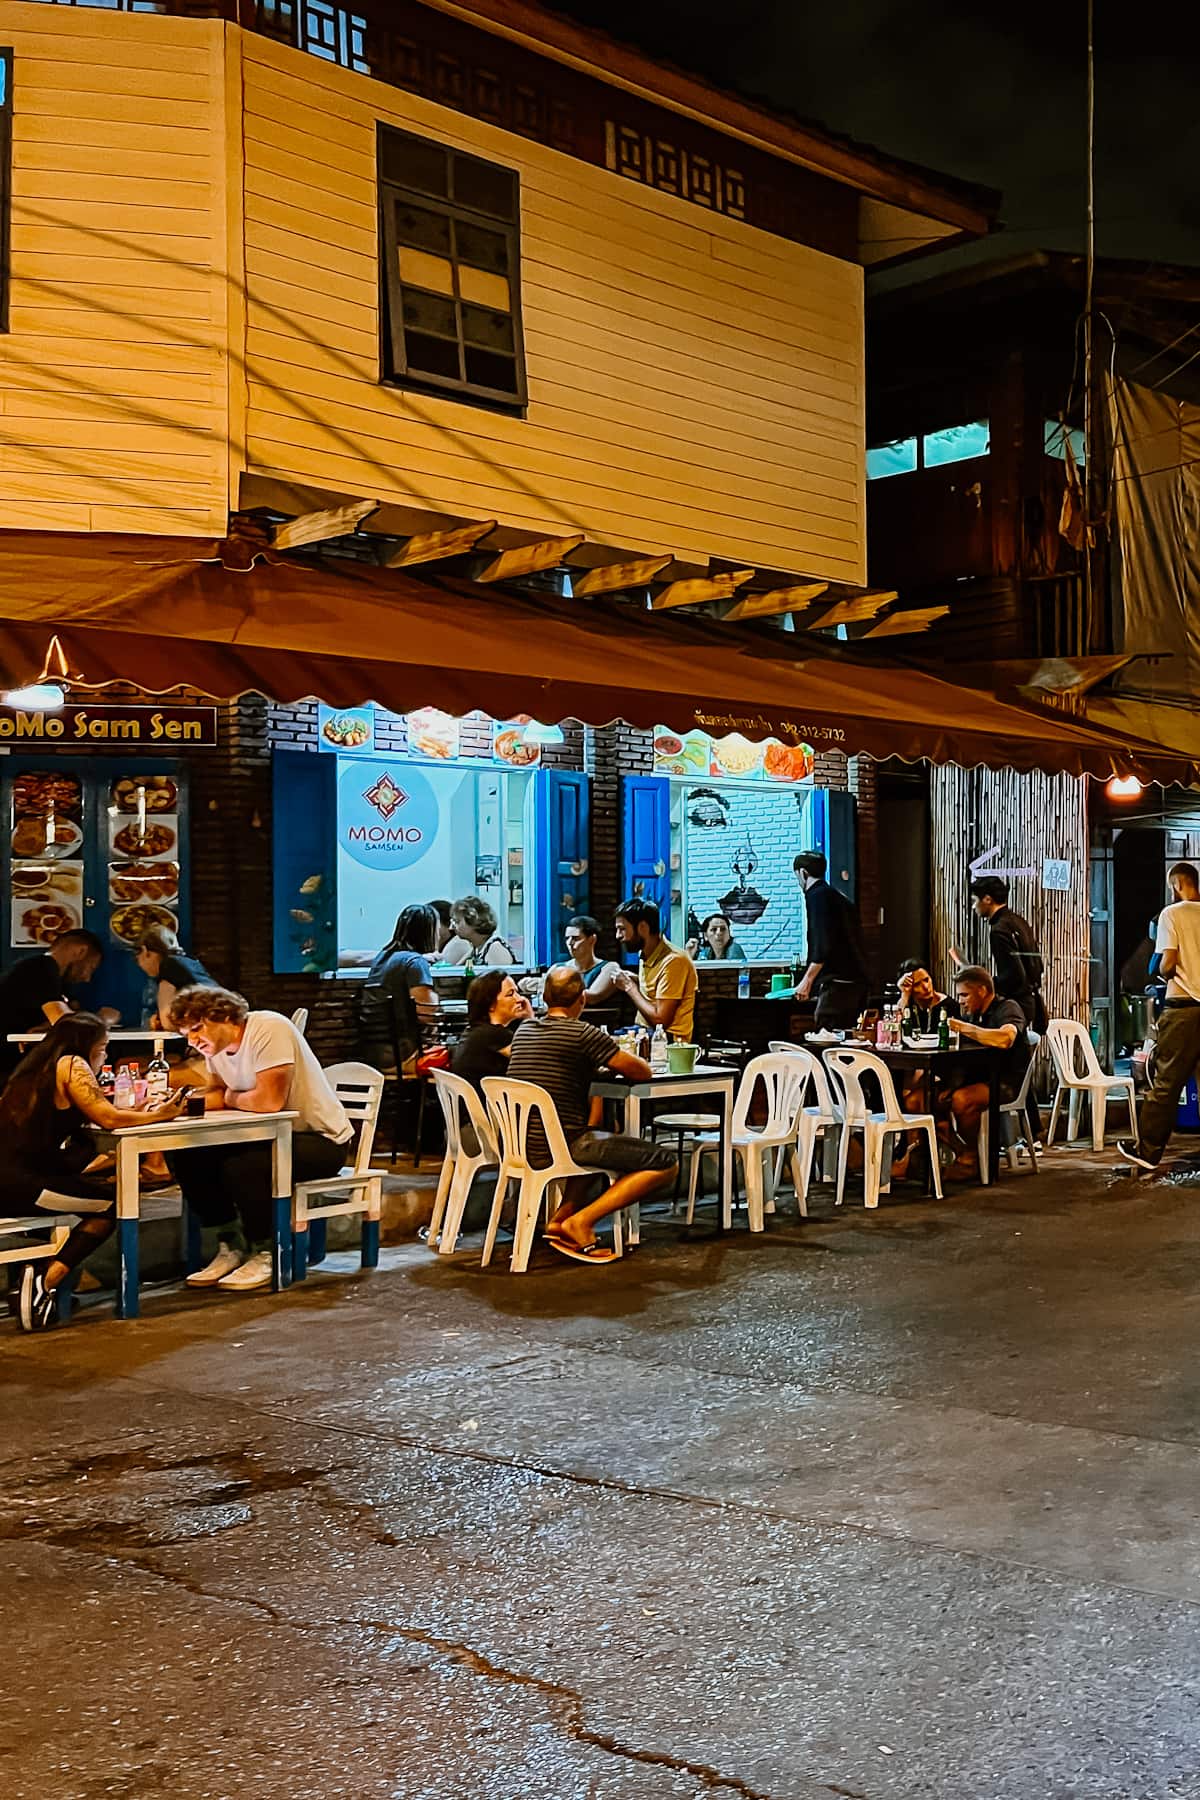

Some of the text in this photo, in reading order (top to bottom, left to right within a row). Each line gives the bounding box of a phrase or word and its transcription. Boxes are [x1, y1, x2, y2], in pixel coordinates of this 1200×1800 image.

[0, 711, 201, 739] oMo Sam Sen
[348, 826, 422, 843] MOMO
